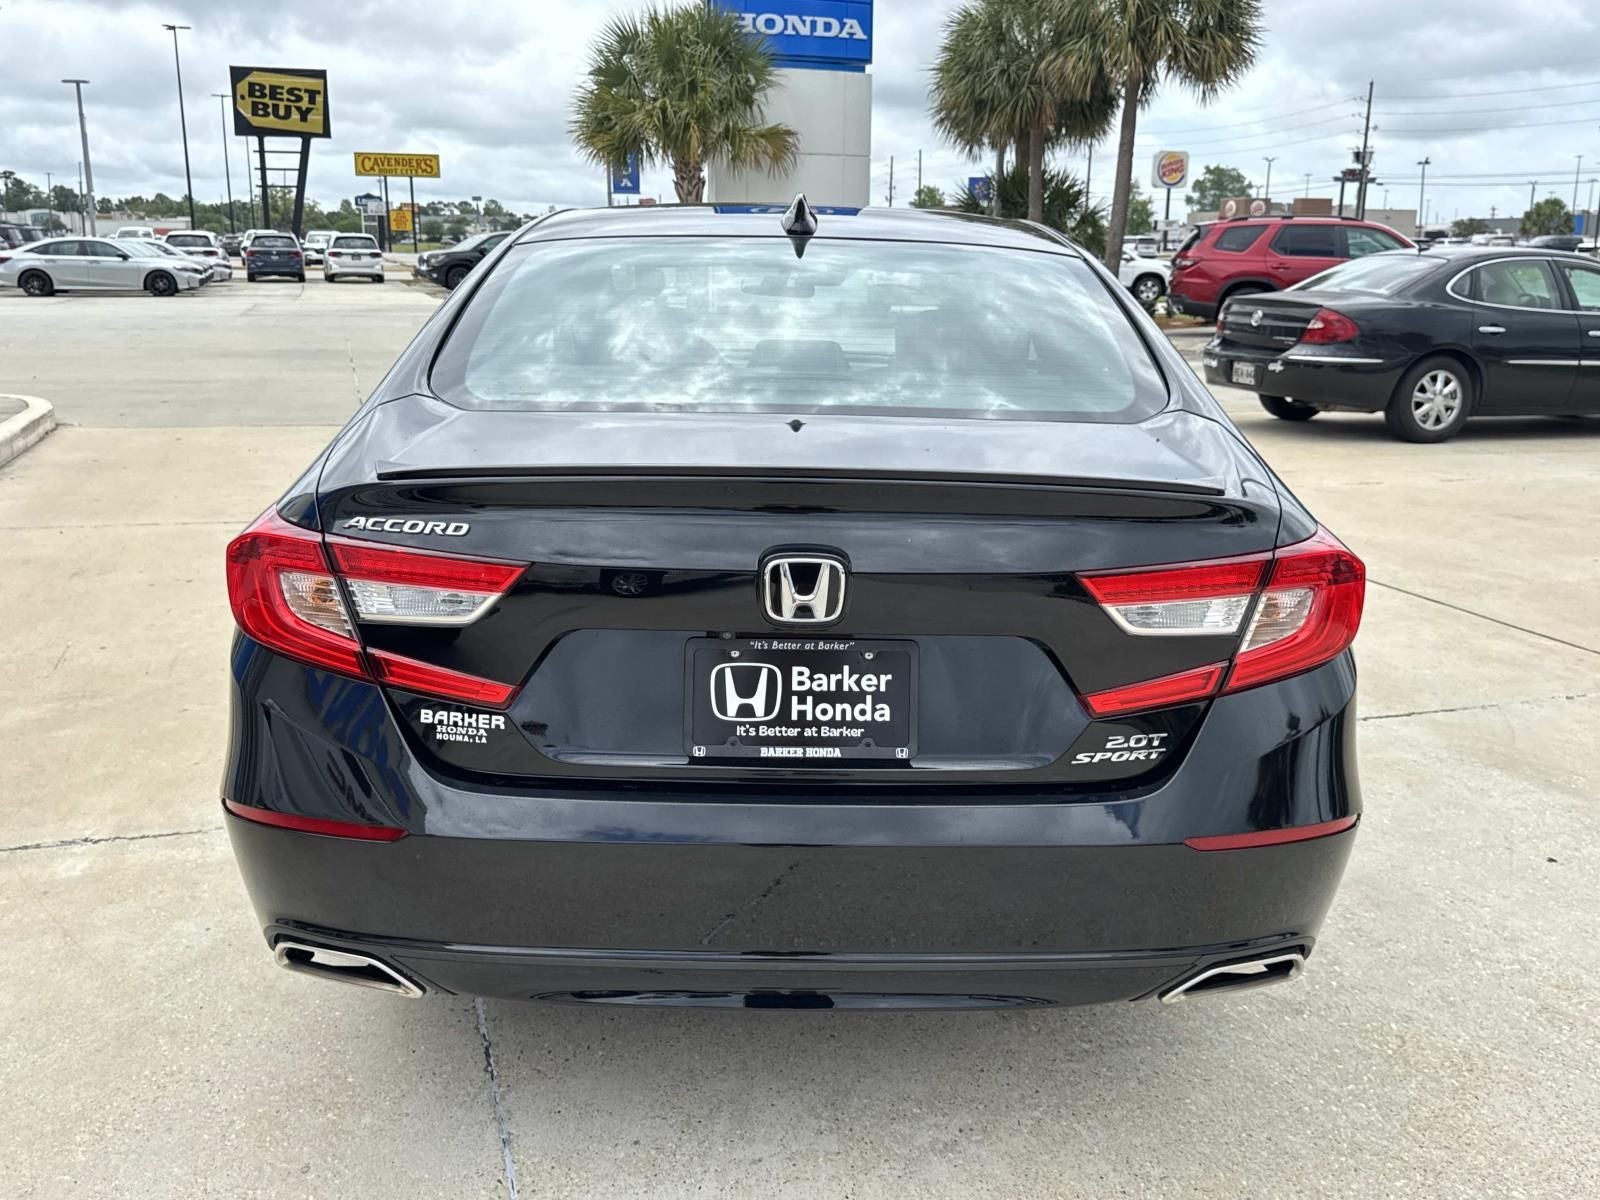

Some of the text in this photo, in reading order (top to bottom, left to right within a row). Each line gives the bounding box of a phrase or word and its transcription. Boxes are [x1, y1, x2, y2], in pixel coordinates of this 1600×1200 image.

[724, 12, 868, 40] HONDA
[247, 81, 321, 105] BEST
[251, 101, 315, 123] BUY
[361, 155, 434, 175] CAVENDER'S
[342, 516, 470, 536] ACCORD
[772, 641, 801, 650] Better
[805, 641, 815, 650] at
[791, 665, 892, 692] Barker
[791, 695, 891, 722] Honda
[420, 708, 505, 730] BARKER
[436, 725, 488, 736] HONDA
[436, 733, 473, 743] HOUMA,
[736, 724, 865, 737] It's Better at Barker
[1105, 733, 1169, 749] 2.0T
[760, 747, 842, 758] BARKER HONDA
[1071, 748, 1167, 764] SPORT
